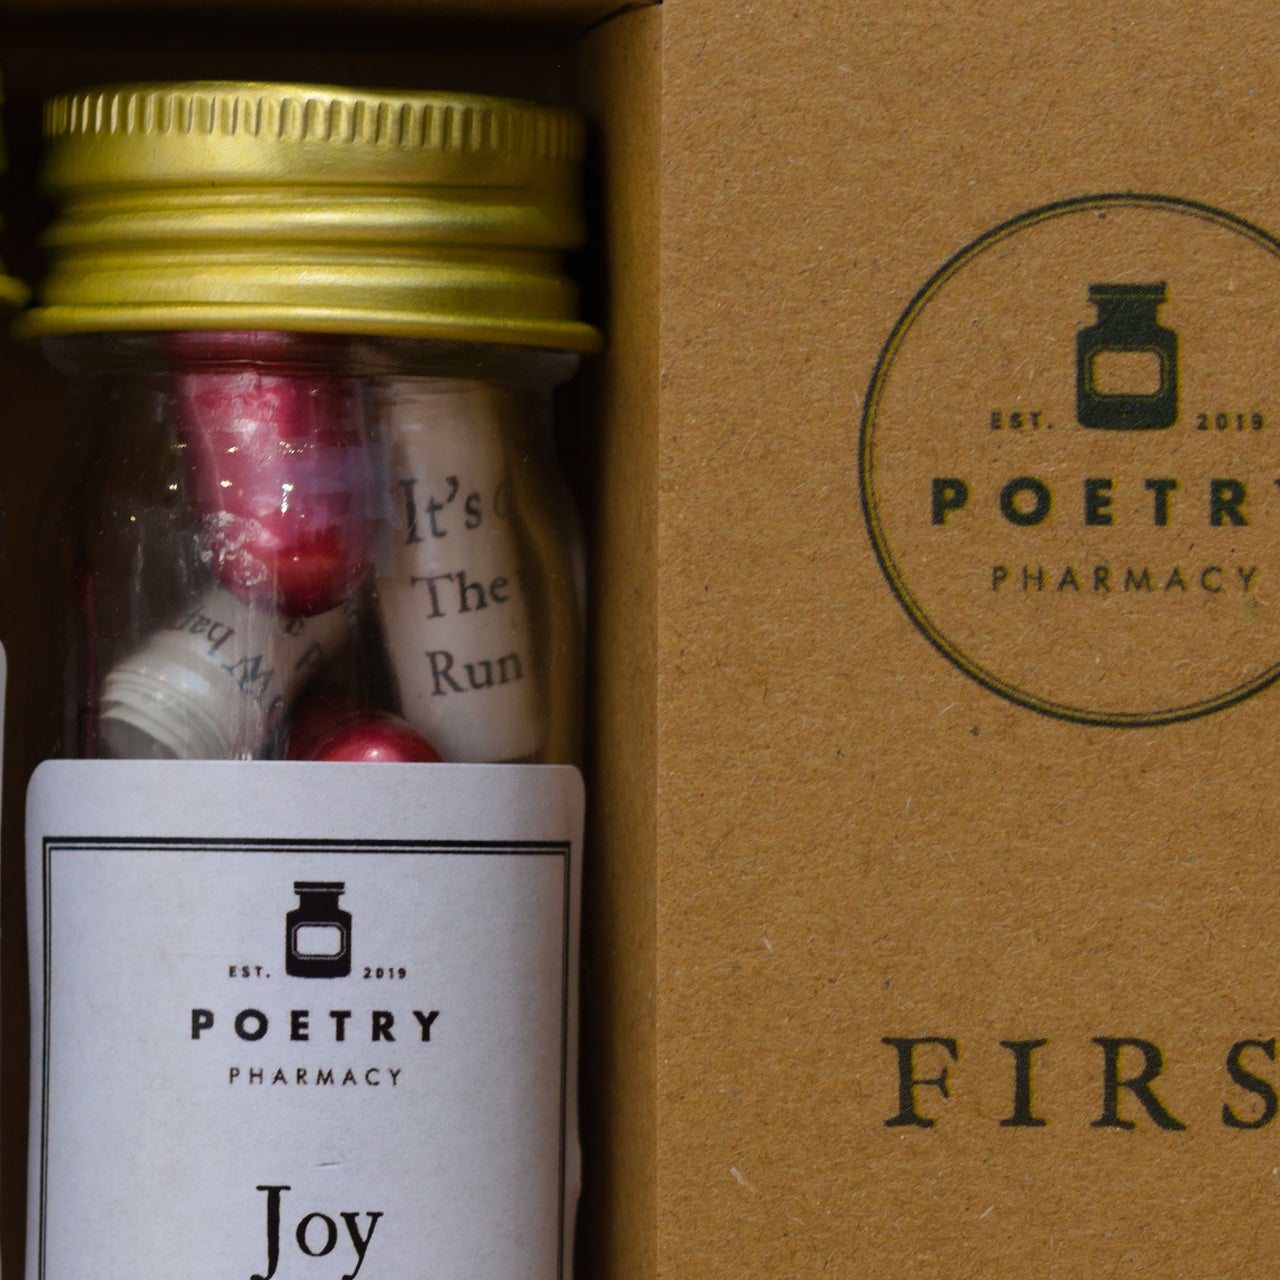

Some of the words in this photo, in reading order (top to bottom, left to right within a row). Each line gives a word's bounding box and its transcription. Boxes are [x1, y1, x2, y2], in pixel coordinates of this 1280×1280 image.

[989, 410, 1054, 431] EST.
[400, 474, 483, 545] It's
[411, 570, 510, 620] The
[991, 564, 1257, 594] PHARMACY
[426, 648, 523, 697] Run
[228, 965, 271, 979] EST.
[363, 966, 407, 980] 2019
[191, 1008, 440, 1043] POETRY
[229, 1067, 402, 1087] PHARMACY
